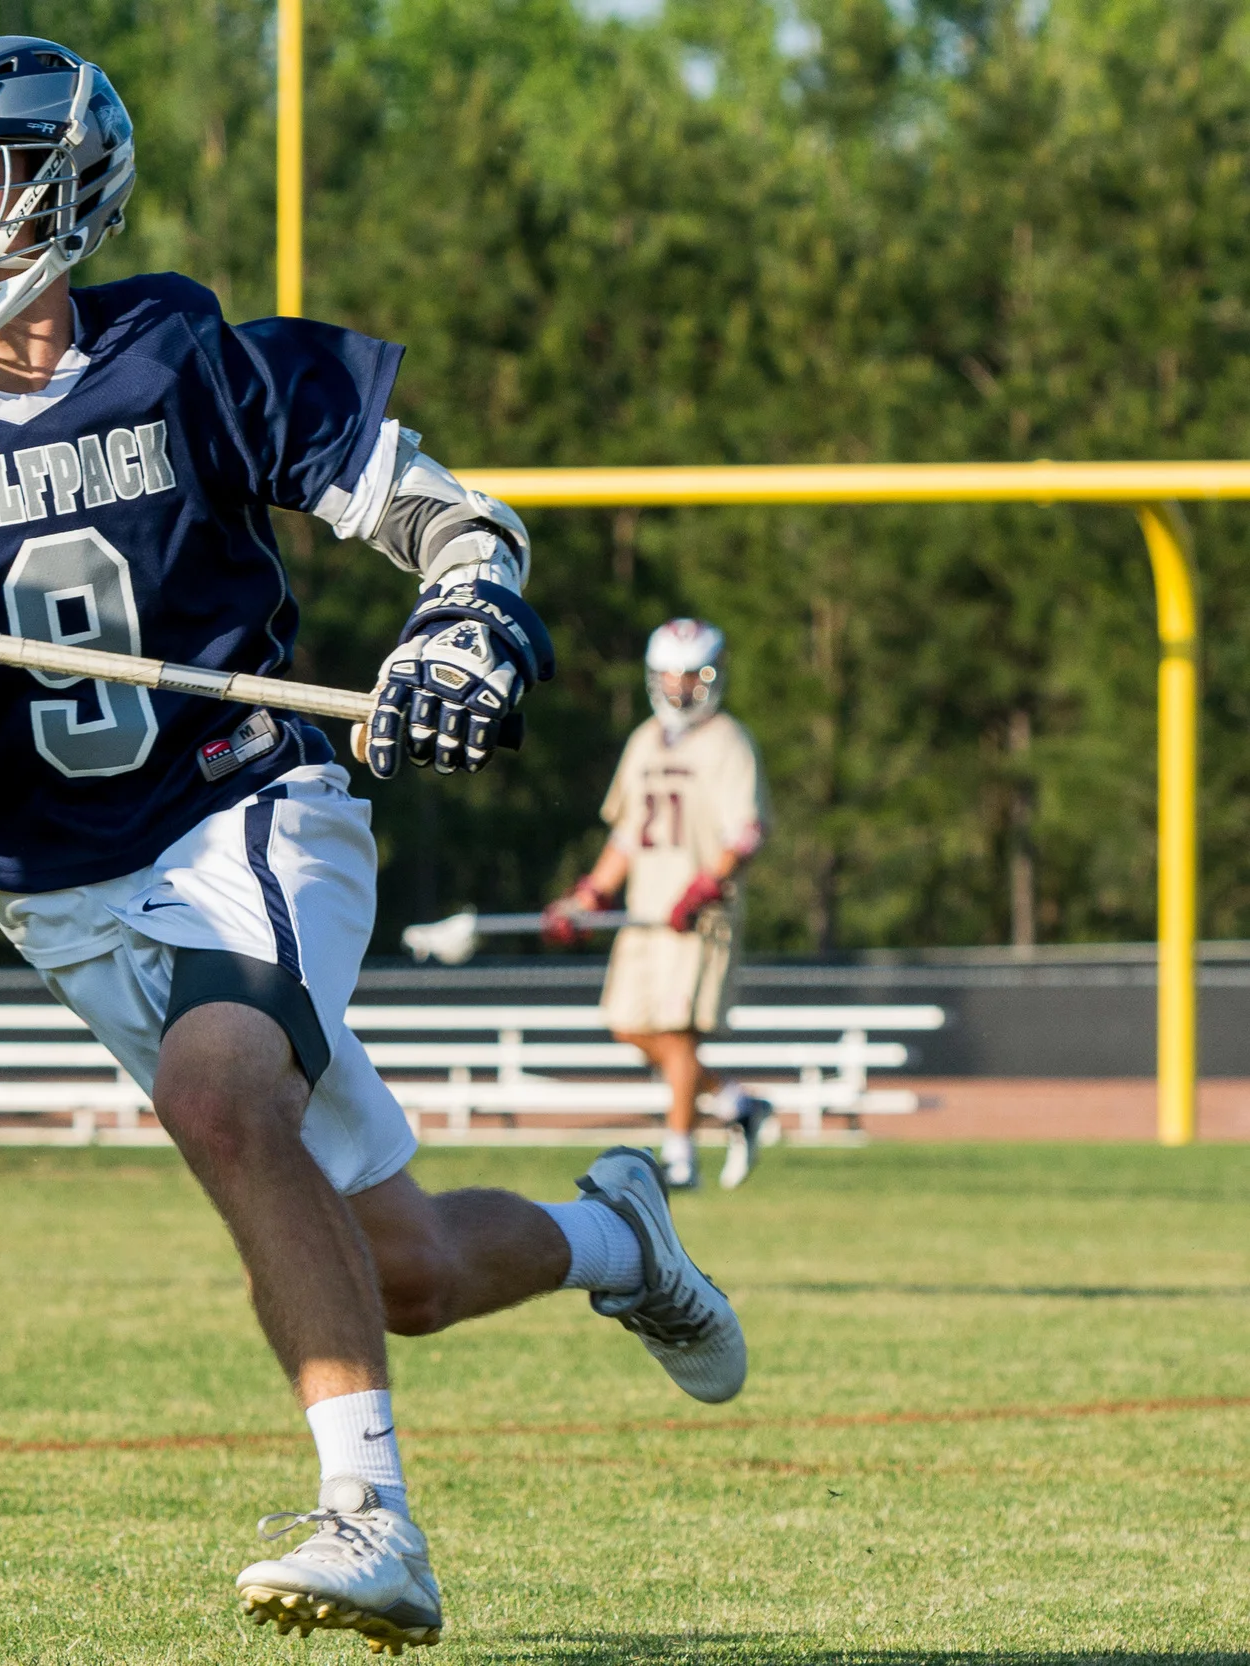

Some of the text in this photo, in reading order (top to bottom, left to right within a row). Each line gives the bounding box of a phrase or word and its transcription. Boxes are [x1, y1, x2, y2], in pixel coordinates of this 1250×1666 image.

[2, 526, 159, 778] 9
[238, 724, 256, 740] M
[206, 748, 231, 762] TEAM
